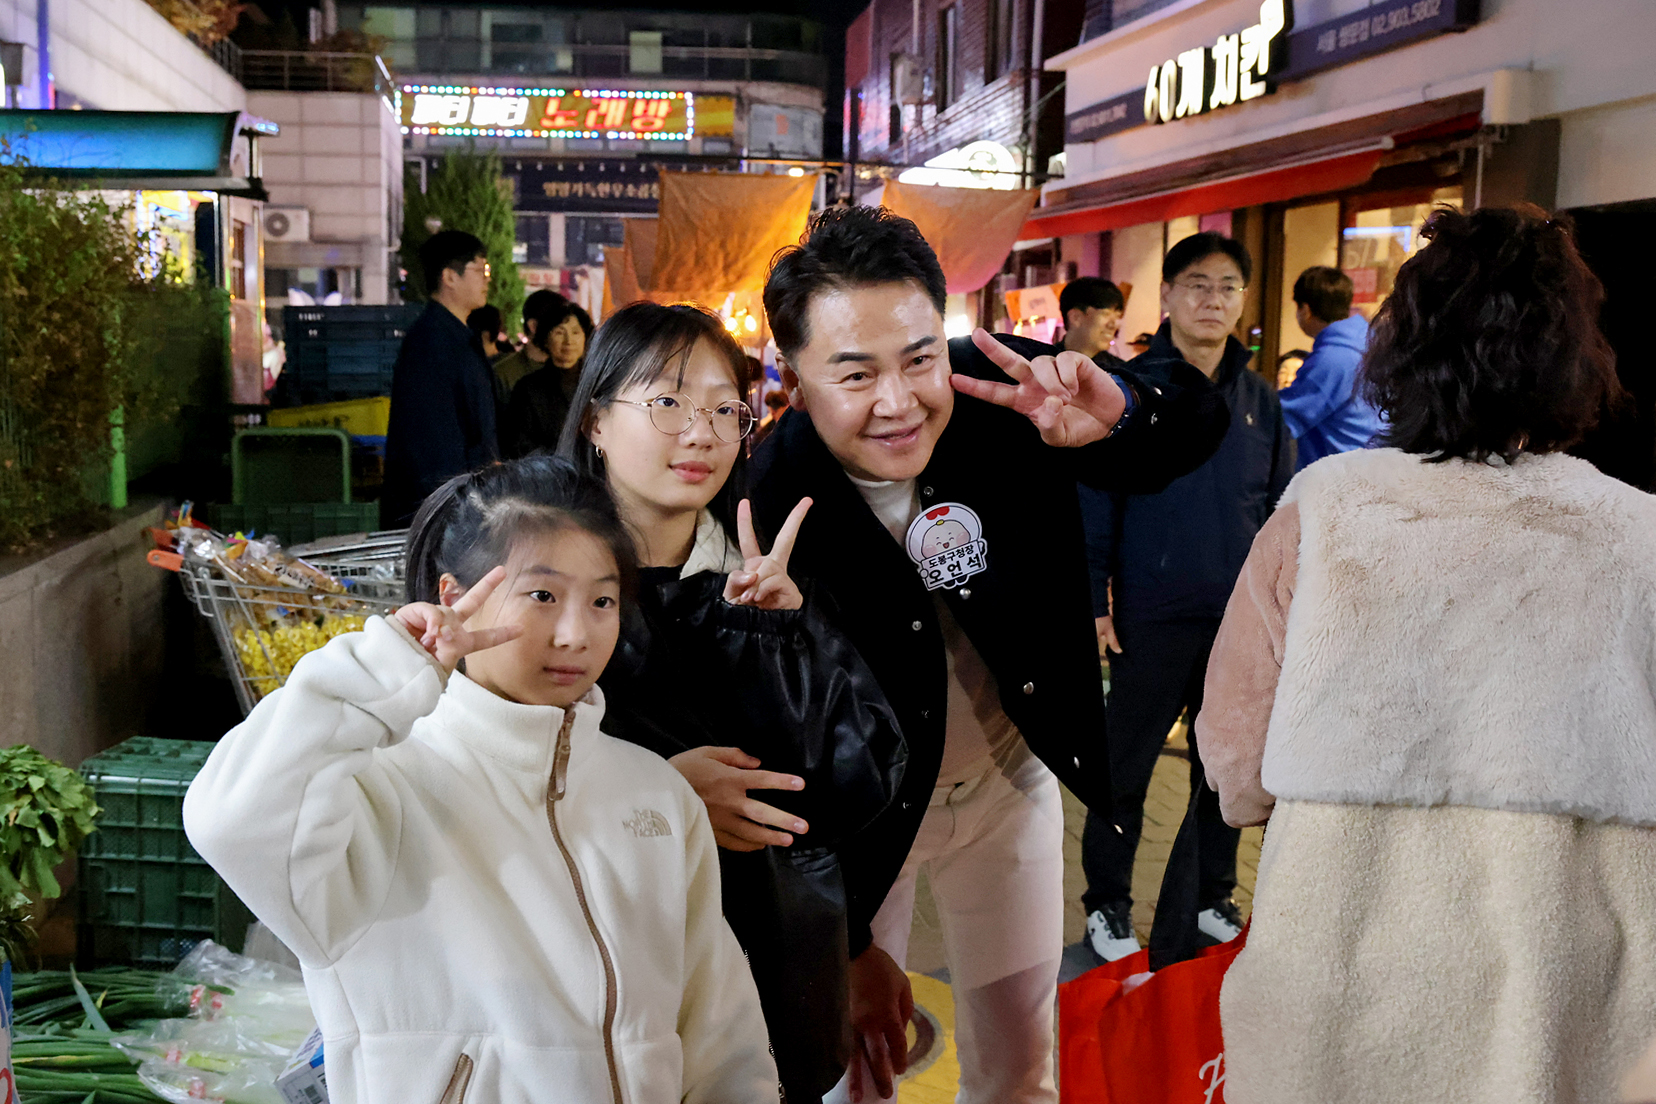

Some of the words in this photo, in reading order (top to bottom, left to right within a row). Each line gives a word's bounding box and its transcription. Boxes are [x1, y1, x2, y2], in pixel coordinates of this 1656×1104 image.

[1143, 45, 1205, 125] 60계
[1209, 0, 1285, 109] 치킨
[540, 97, 672, 131] 노래방
[928, 543, 975, 569] 도봉구청장
[928, 552, 982, 585] 오언석
